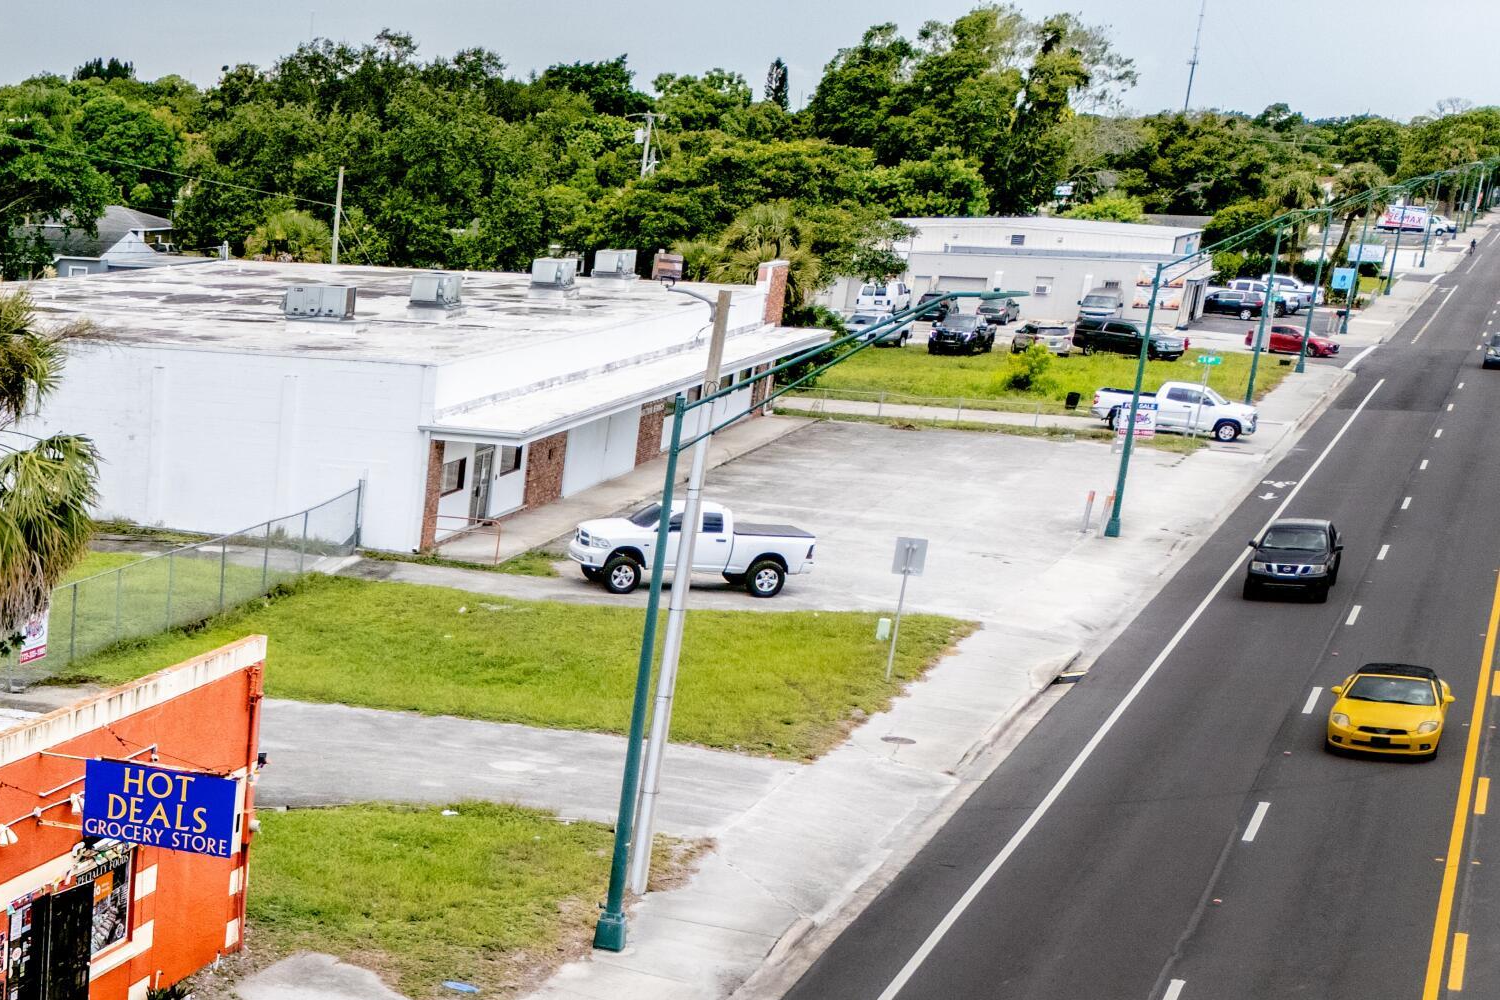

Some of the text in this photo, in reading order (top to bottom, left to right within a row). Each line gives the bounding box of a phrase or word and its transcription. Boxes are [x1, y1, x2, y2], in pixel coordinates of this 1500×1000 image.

[123, 767, 196, 803] HOT
[107, 794, 208, 834] DEALS
[85, 818, 227, 856] GROCERY STORE
